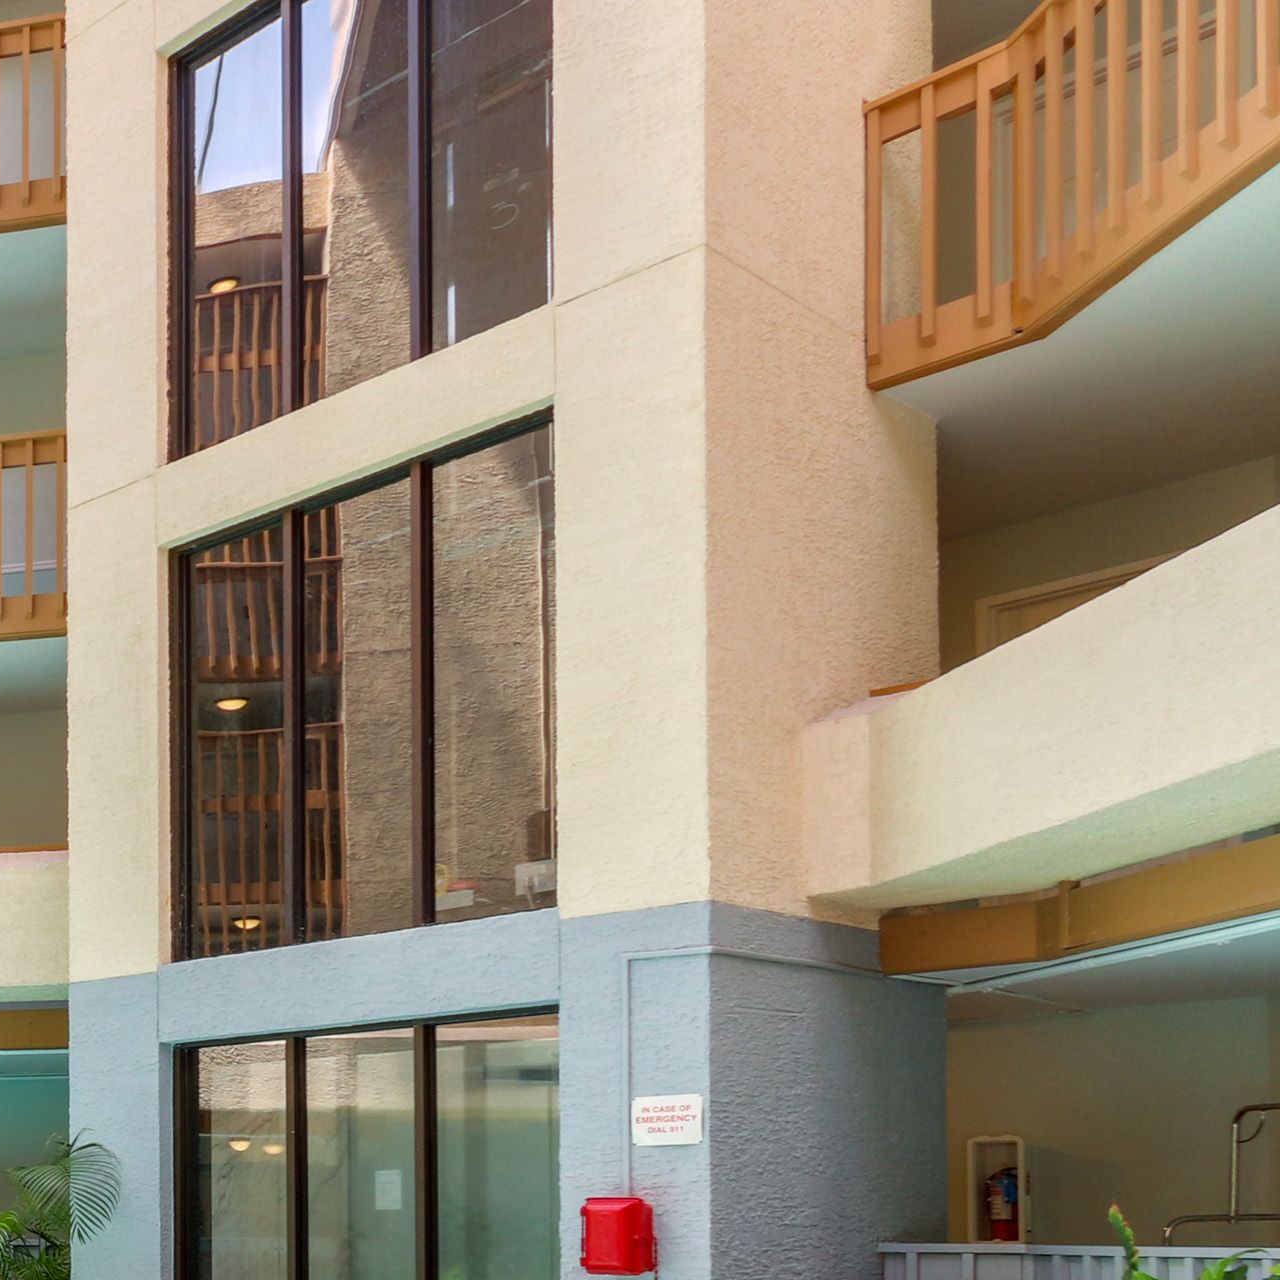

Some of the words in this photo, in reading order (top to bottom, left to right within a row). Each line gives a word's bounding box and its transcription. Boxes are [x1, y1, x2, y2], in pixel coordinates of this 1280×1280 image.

[652, 1105, 676, 1113] CASE
[679, 1104, 692, 1112] OF
[635, 1114, 697, 1124] EMERGENCY
